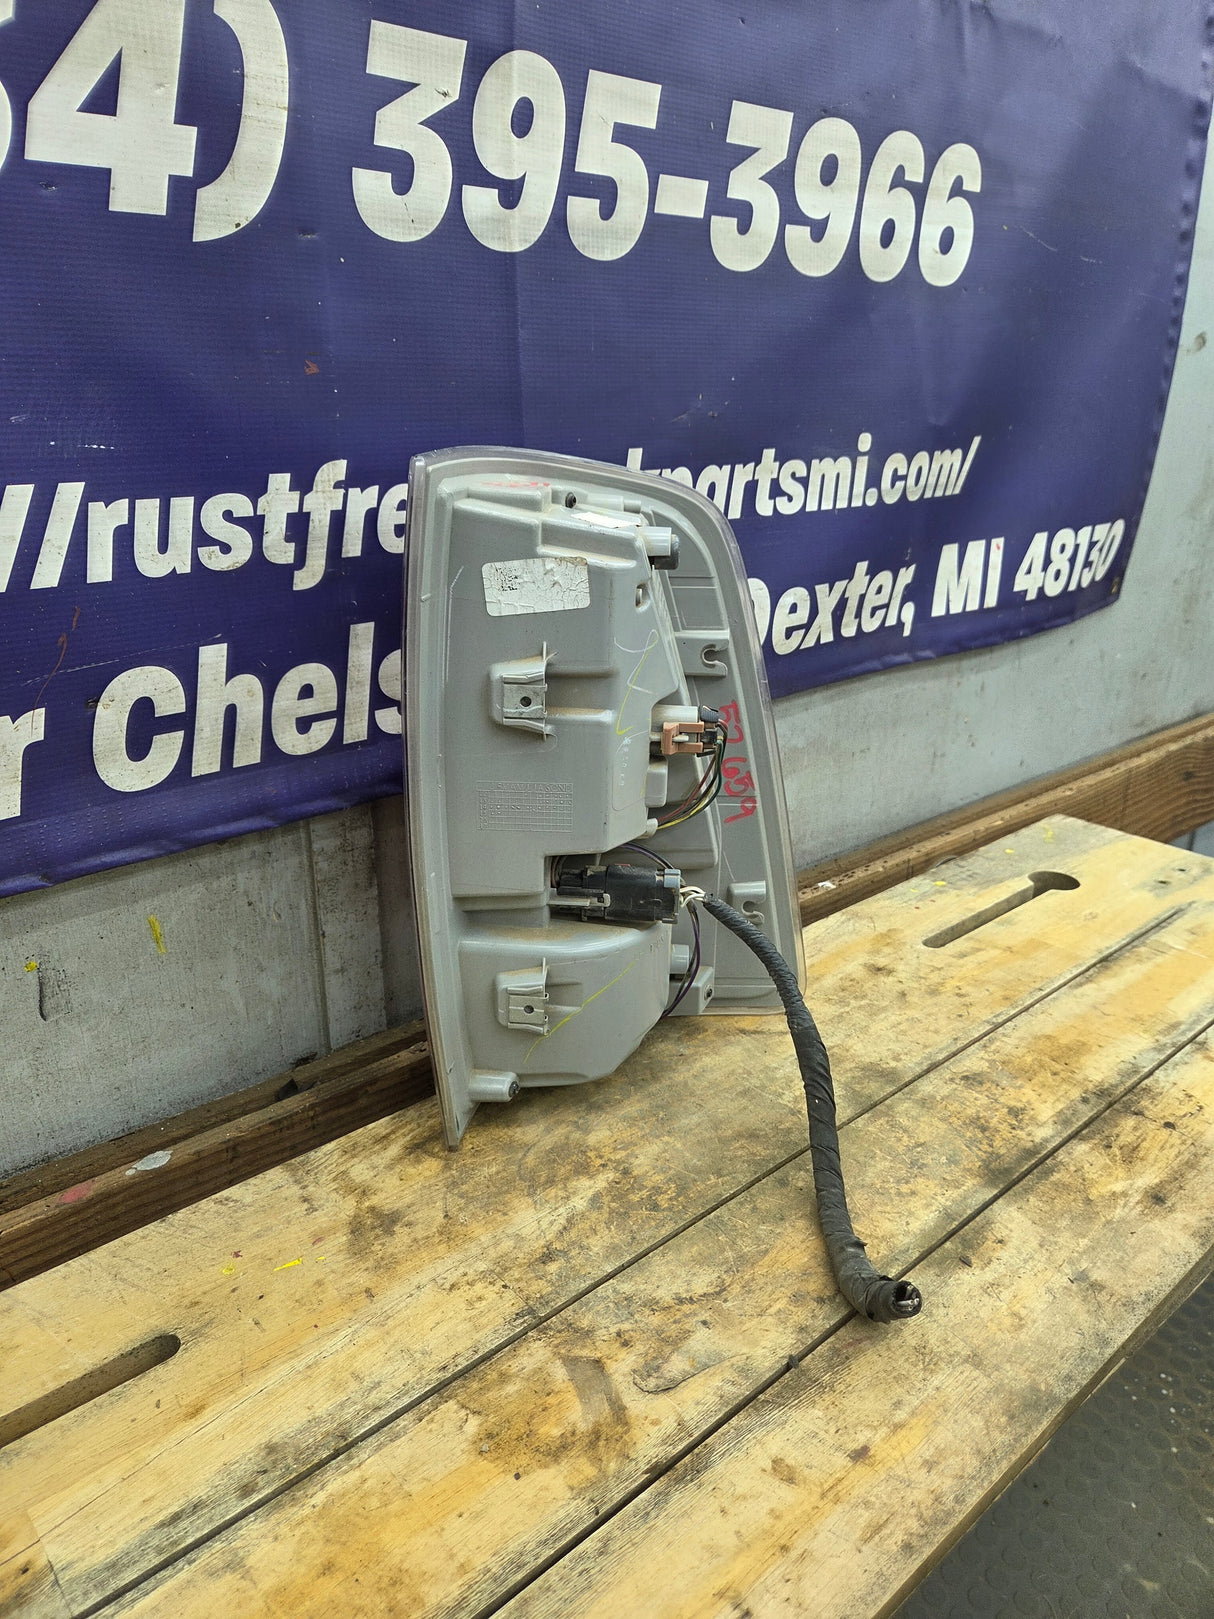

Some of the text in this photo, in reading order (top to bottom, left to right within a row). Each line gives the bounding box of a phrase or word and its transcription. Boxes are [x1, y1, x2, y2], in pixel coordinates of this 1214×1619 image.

[0, 0, 982, 287] 4) 395-3966
[930, 536, 1005, 618] MI
[1012, 518, 1126, 602] 48130
